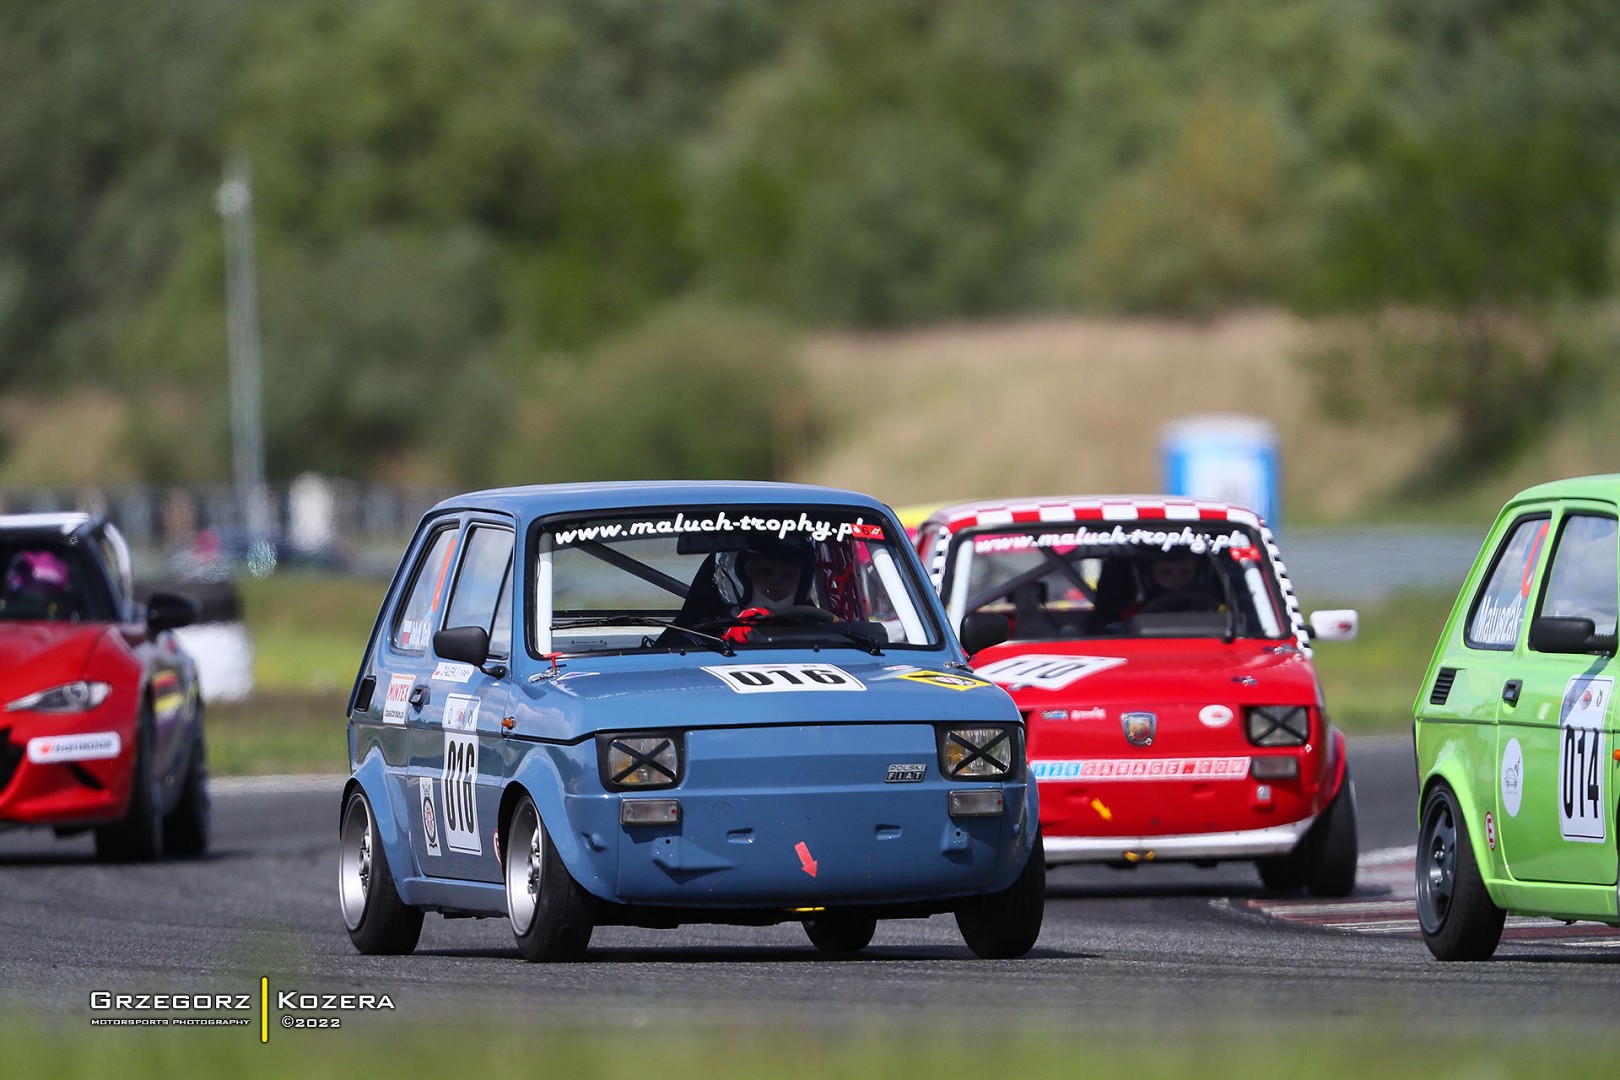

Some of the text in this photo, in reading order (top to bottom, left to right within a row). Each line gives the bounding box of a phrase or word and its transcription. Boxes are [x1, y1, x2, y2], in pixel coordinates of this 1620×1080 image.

[1475, 595, 1523, 643] Matuszak
[728, 669, 847, 686] 016
[445, 740, 475, 834] 016
[887, 771, 923, 780] FIAT
[1563, 724, 1600, 819] 014
